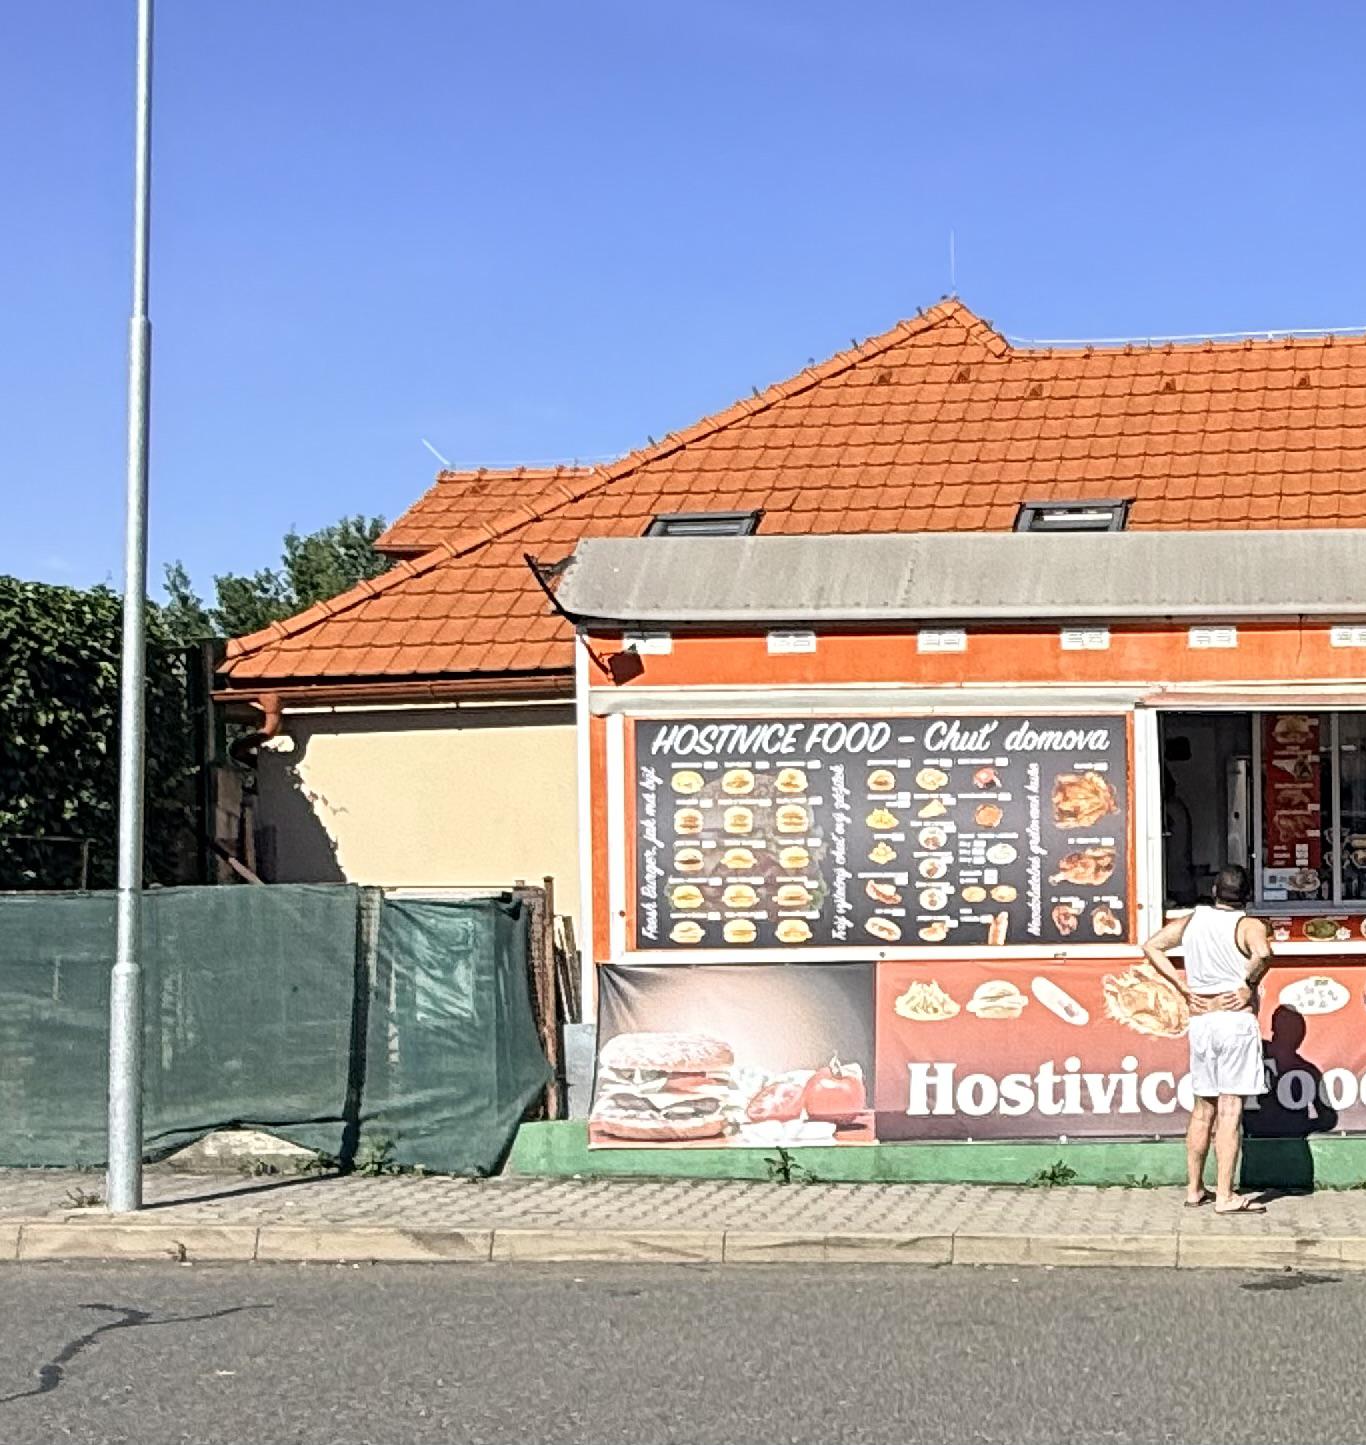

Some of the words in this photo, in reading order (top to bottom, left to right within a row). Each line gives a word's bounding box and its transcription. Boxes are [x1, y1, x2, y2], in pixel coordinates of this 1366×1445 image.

[651, 723, 804, 755] HOSTIVICE
[805, 721, 891, 753] FOOD
[923, 719, 999, 752] Chuť
[1004, 719, 1111, 751] domova
[640, 818, 665, 849] jak
[639, 901, 658, 940] Fresh
